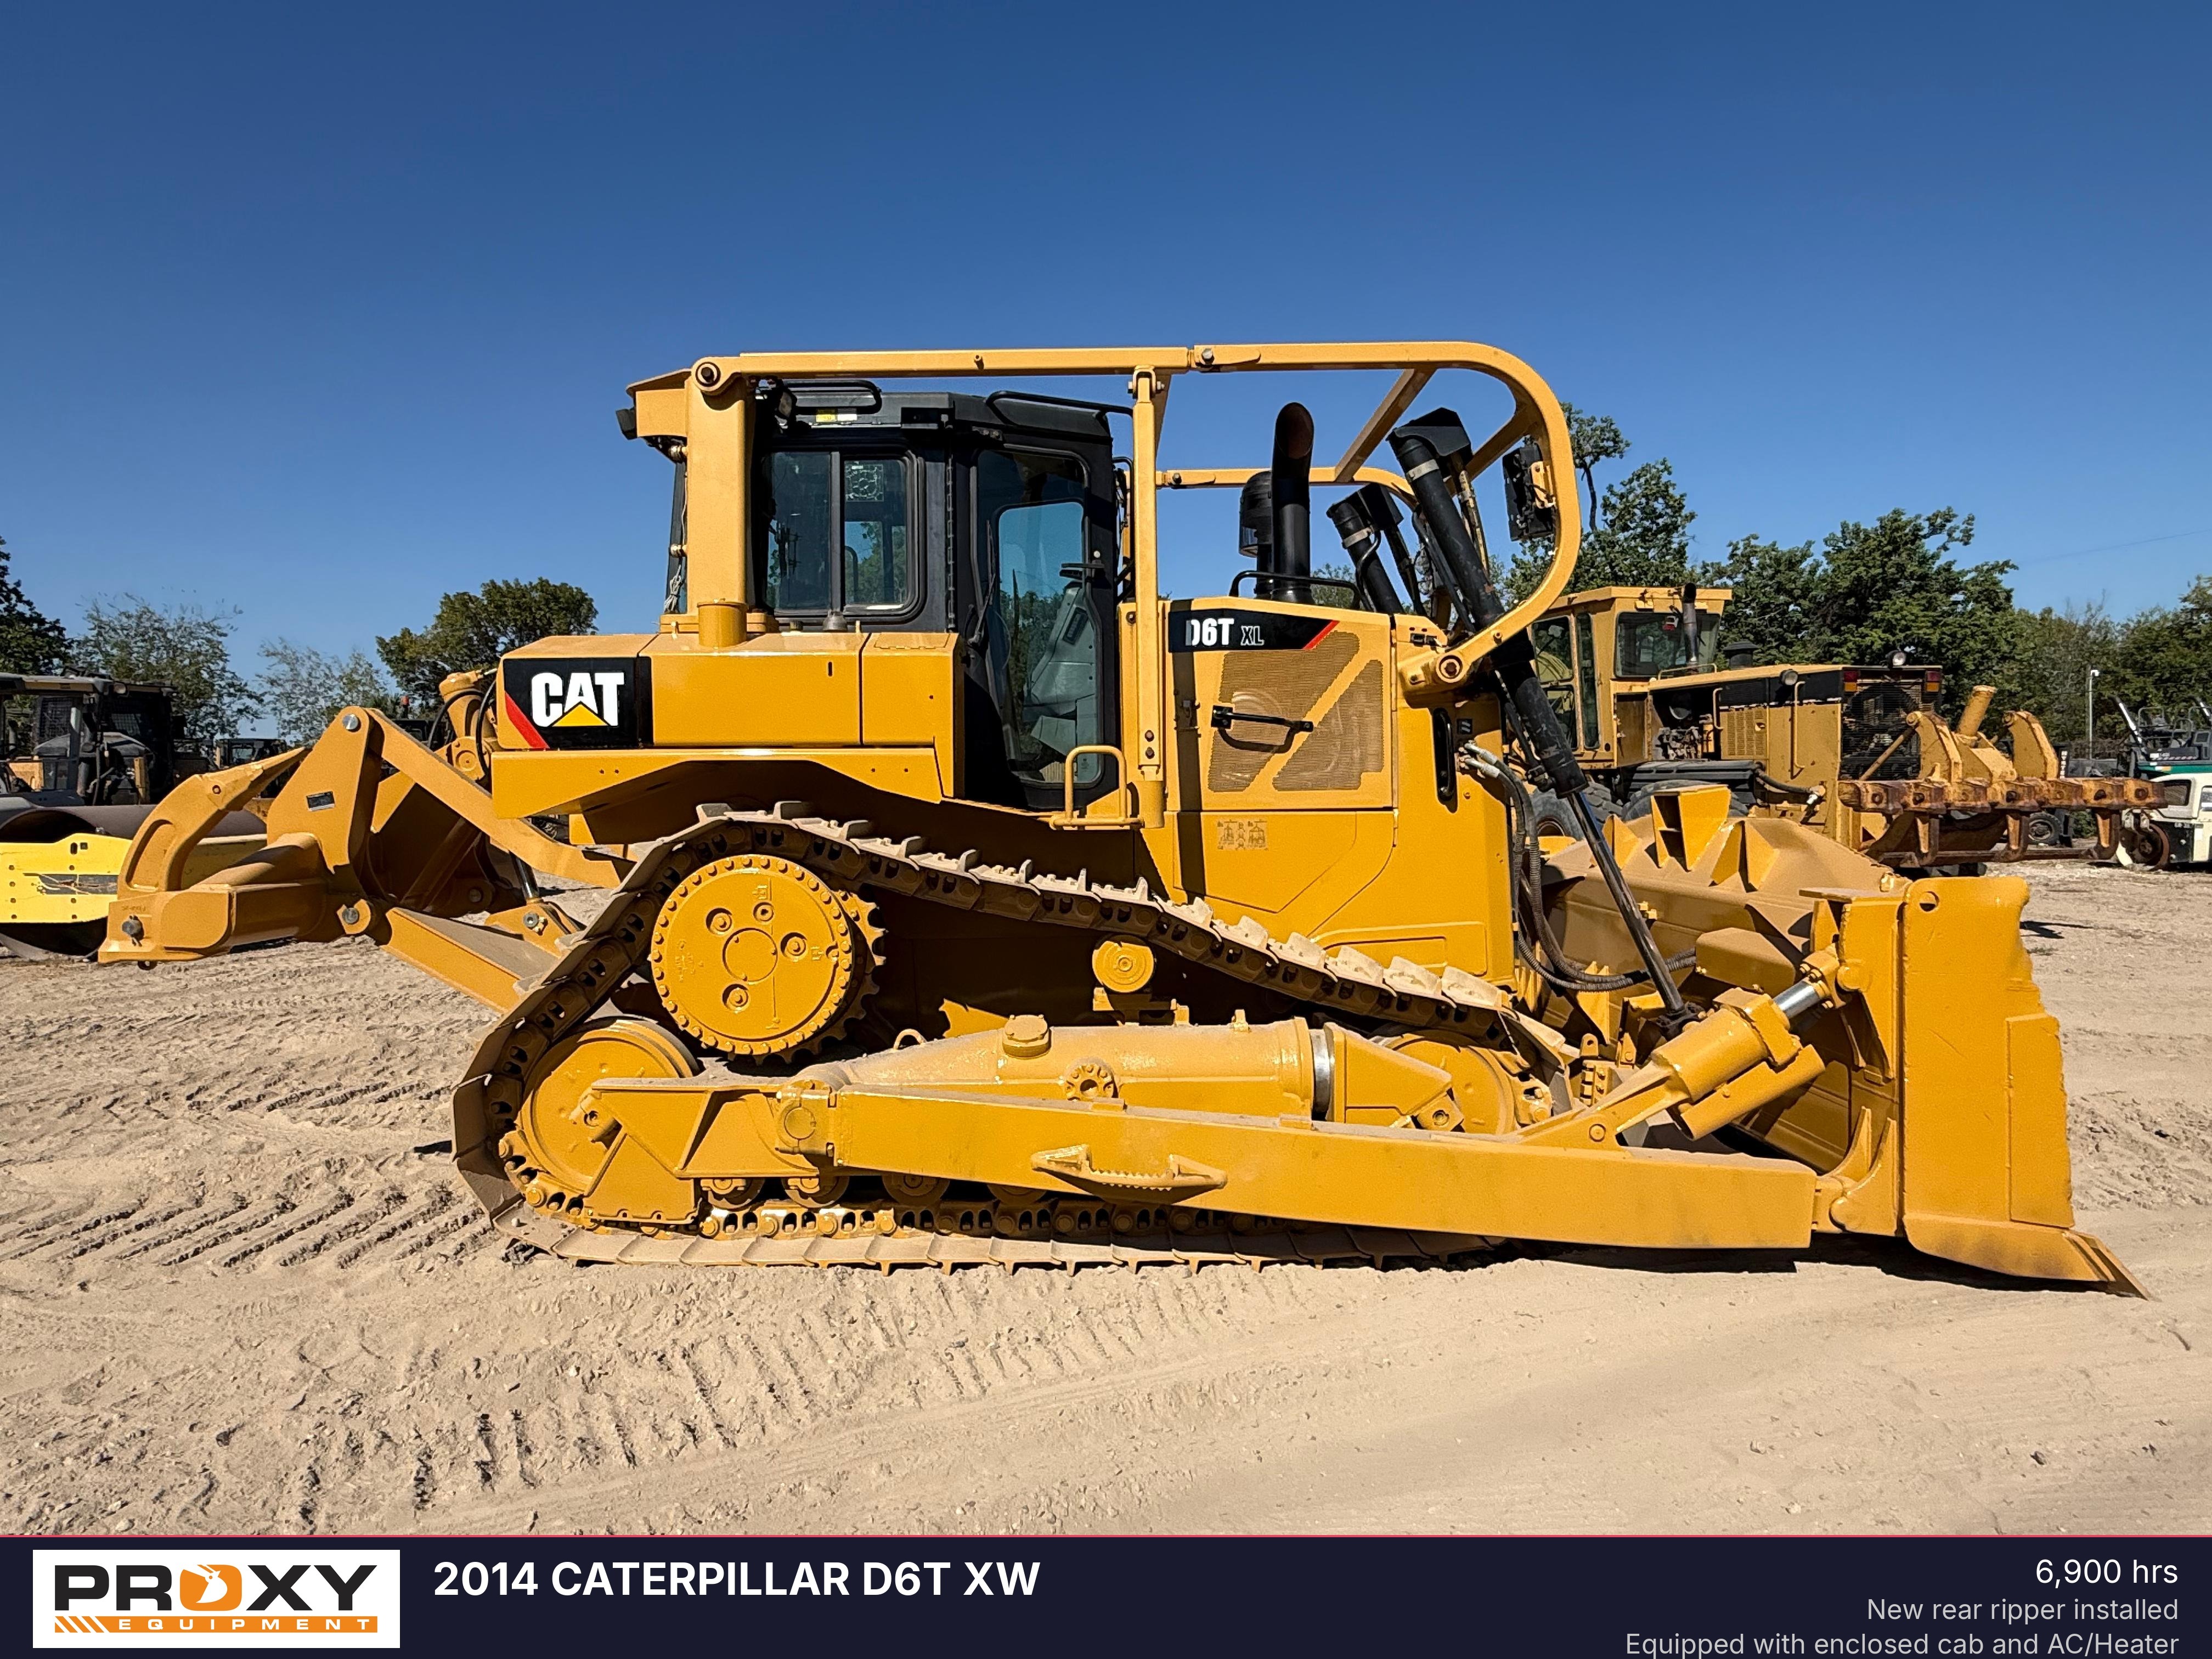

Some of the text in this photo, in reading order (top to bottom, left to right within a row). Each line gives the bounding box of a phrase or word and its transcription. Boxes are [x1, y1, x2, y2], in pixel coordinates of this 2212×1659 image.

[1185, 618, 1265, 647] D6T XL
[531, 672, 624, 727] CAT
